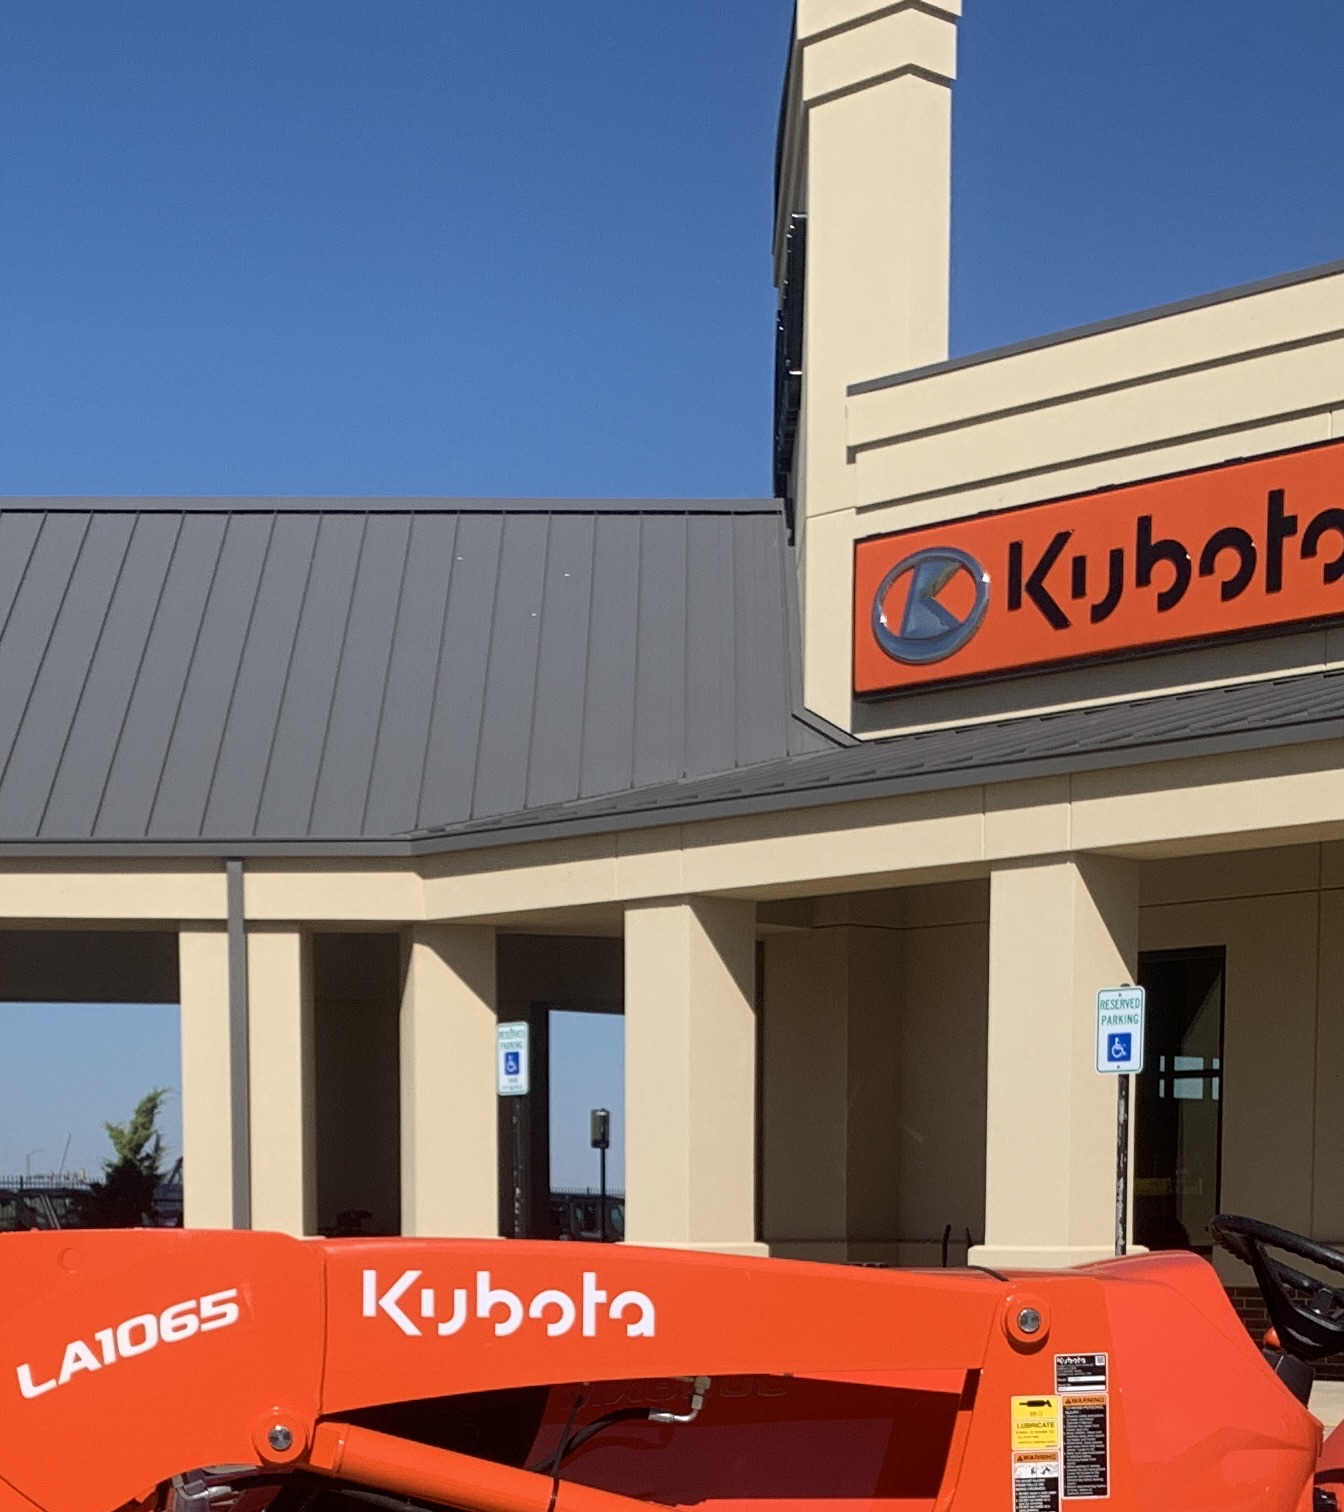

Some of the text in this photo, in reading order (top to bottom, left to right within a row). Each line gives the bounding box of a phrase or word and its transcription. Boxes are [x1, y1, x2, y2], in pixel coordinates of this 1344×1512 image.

[1099, 997, 1141, 1011] RESERVED
[1101, 1013, 1139, 1026] PARKING
[362, 1268, 656, 1338] Kubota
[16, 1287, 240, 1400] LA1065
[1016, 1421, 1055, 1429] LUBRICATE
[1023, 1453, 1057, 1461] WARNING
